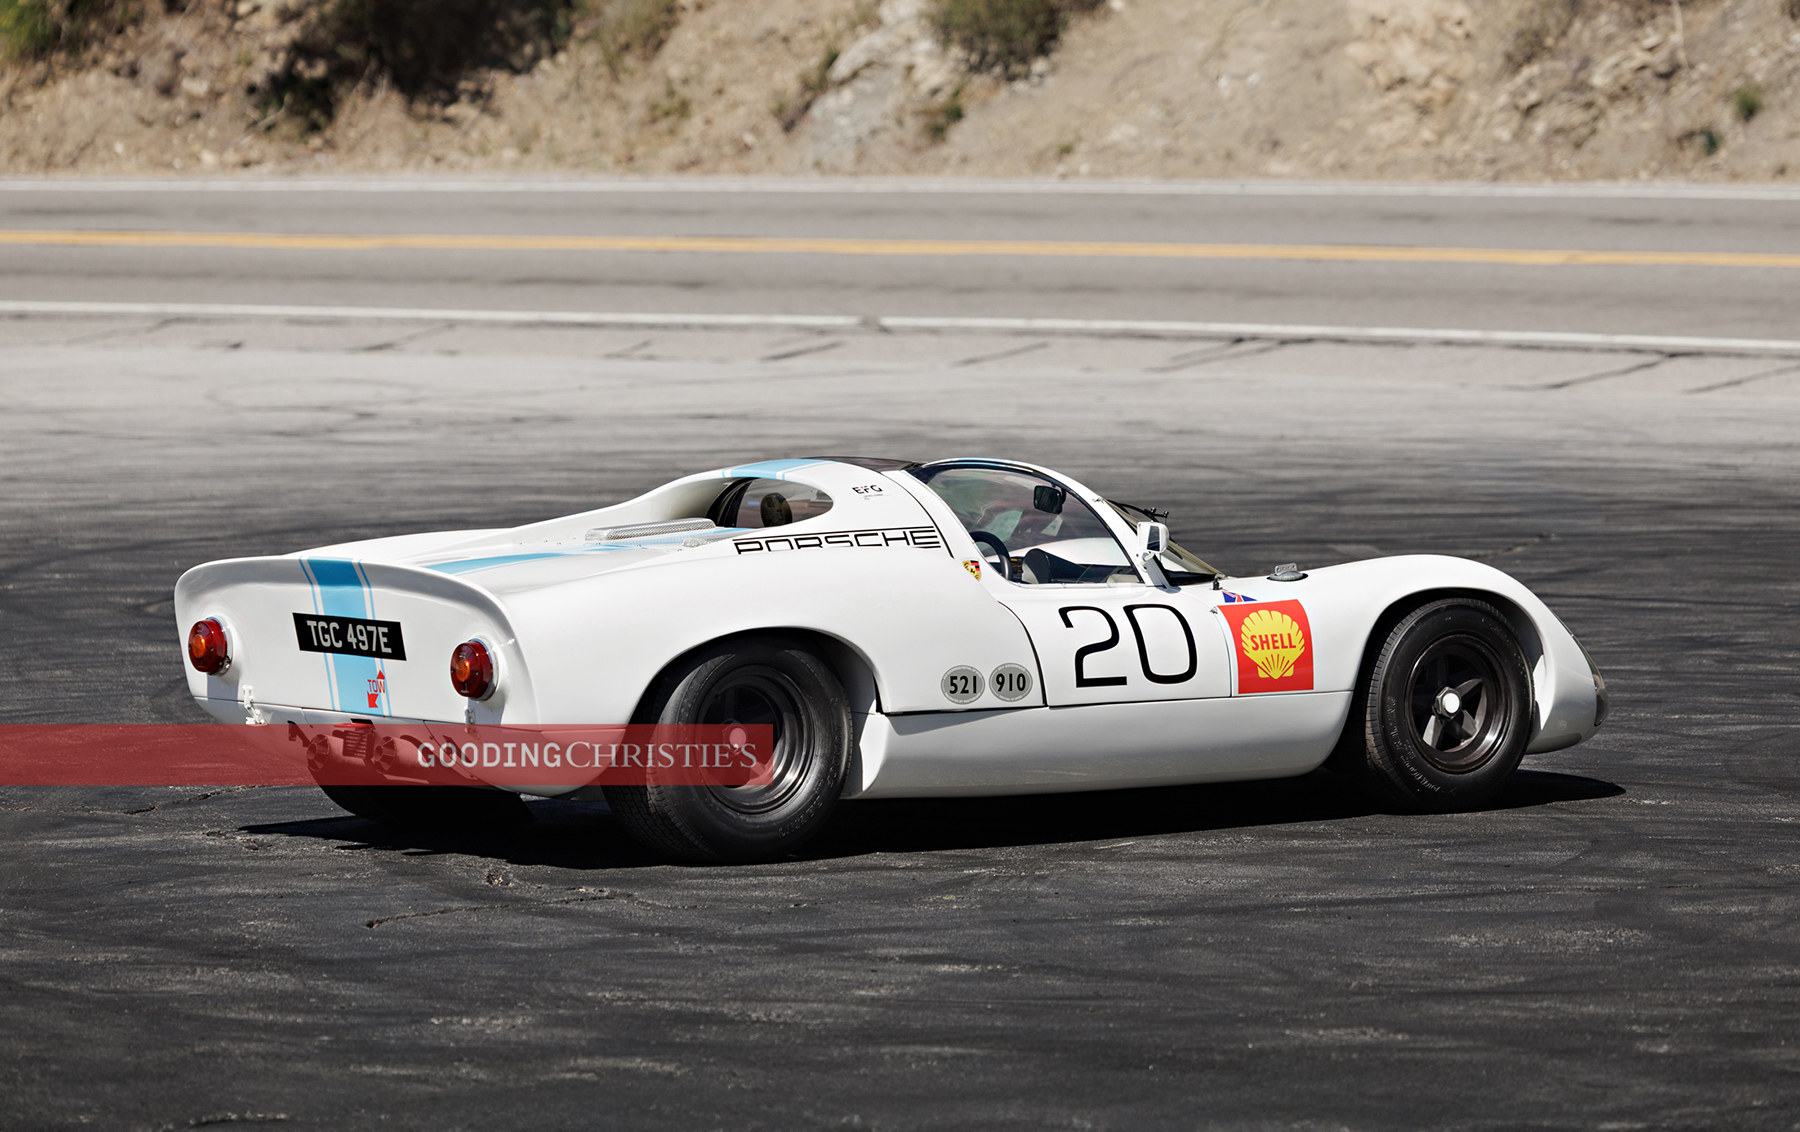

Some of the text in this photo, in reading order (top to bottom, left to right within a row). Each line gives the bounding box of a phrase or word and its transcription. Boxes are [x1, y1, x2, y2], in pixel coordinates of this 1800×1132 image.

[734, 529, 942, 554] PORSCHE
[306, 620, 392, 653] TGC 497E
[1058, 603, 1198, 688] 20
[1250, 632, 1297, 651] SHELL
[367, 679, 386, 694] TOW
[949, 675, 977, 694] 521
[995, 673, 1027, 692] 910
